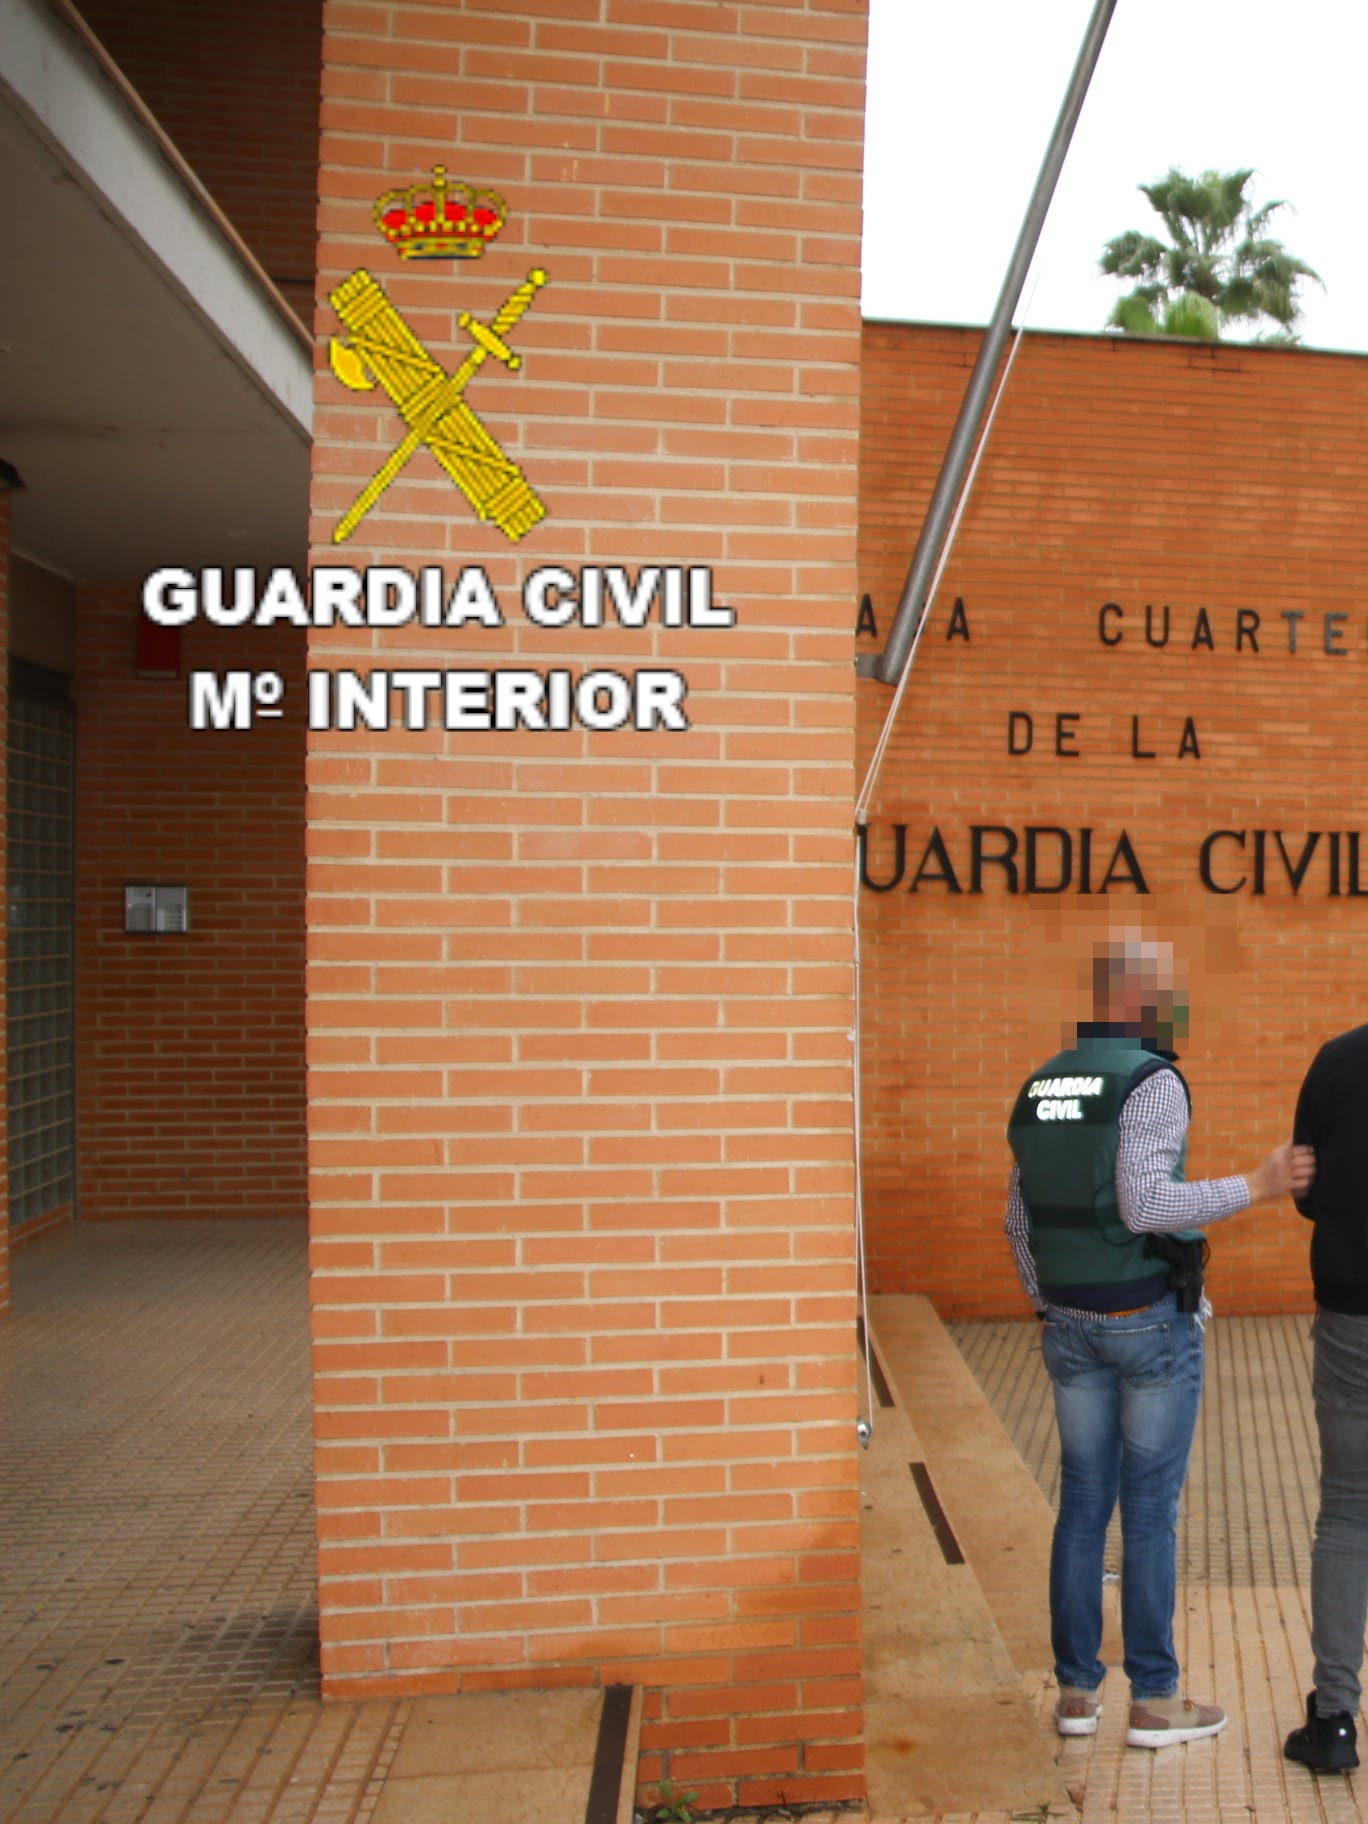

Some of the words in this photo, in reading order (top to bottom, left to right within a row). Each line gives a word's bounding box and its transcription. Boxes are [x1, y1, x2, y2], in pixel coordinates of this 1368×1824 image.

[856, 593, 970, 642] AA
[1008, 711, 1080, 757] DE
[1131, 715, 1201, 759] LA
[857, 824, 1150, 894] UARDIA
[1028, 1077, 1104, 1098] GUARDIA
[1036, 1100, 1083, 1120] CIVIL
